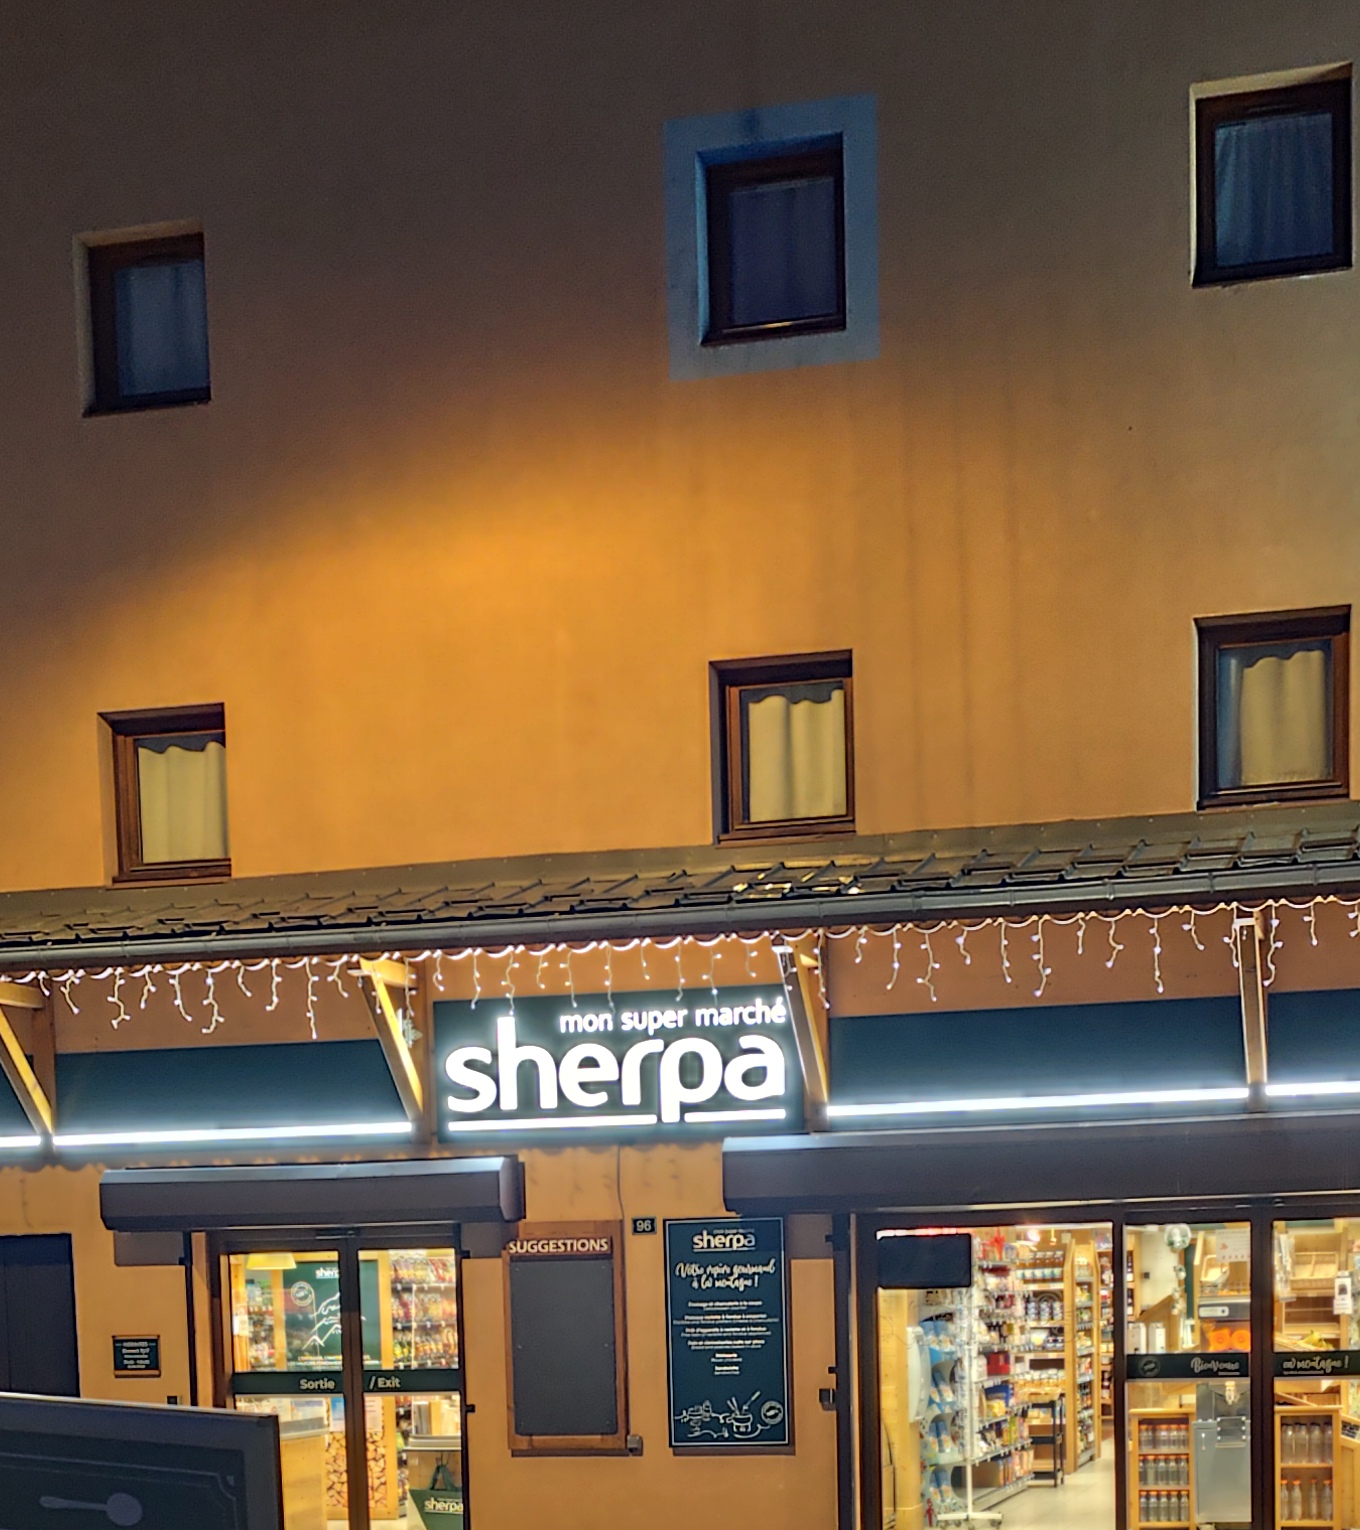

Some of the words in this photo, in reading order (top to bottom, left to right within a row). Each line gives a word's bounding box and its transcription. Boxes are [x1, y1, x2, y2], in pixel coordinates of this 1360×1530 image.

[560, 1014, 613, 1034] mon
[621, 1008, 688, 1034] super
[696, 996, 786, 1027] marché
[445, 1016, 786, 1123] sherpa
[636, 1220, 652, 1232] 96
[508, 1238, 609, 1253] SUGGESTIONS
[693, 1230, 755, 1249] sherpa
[315, 1267, 339, 1278] sherp
[300, 1378, 335, 1390] Sortie
[378, 1377, 401, 1389] Exit
[424, 1497, 463, 1512] sherpa
